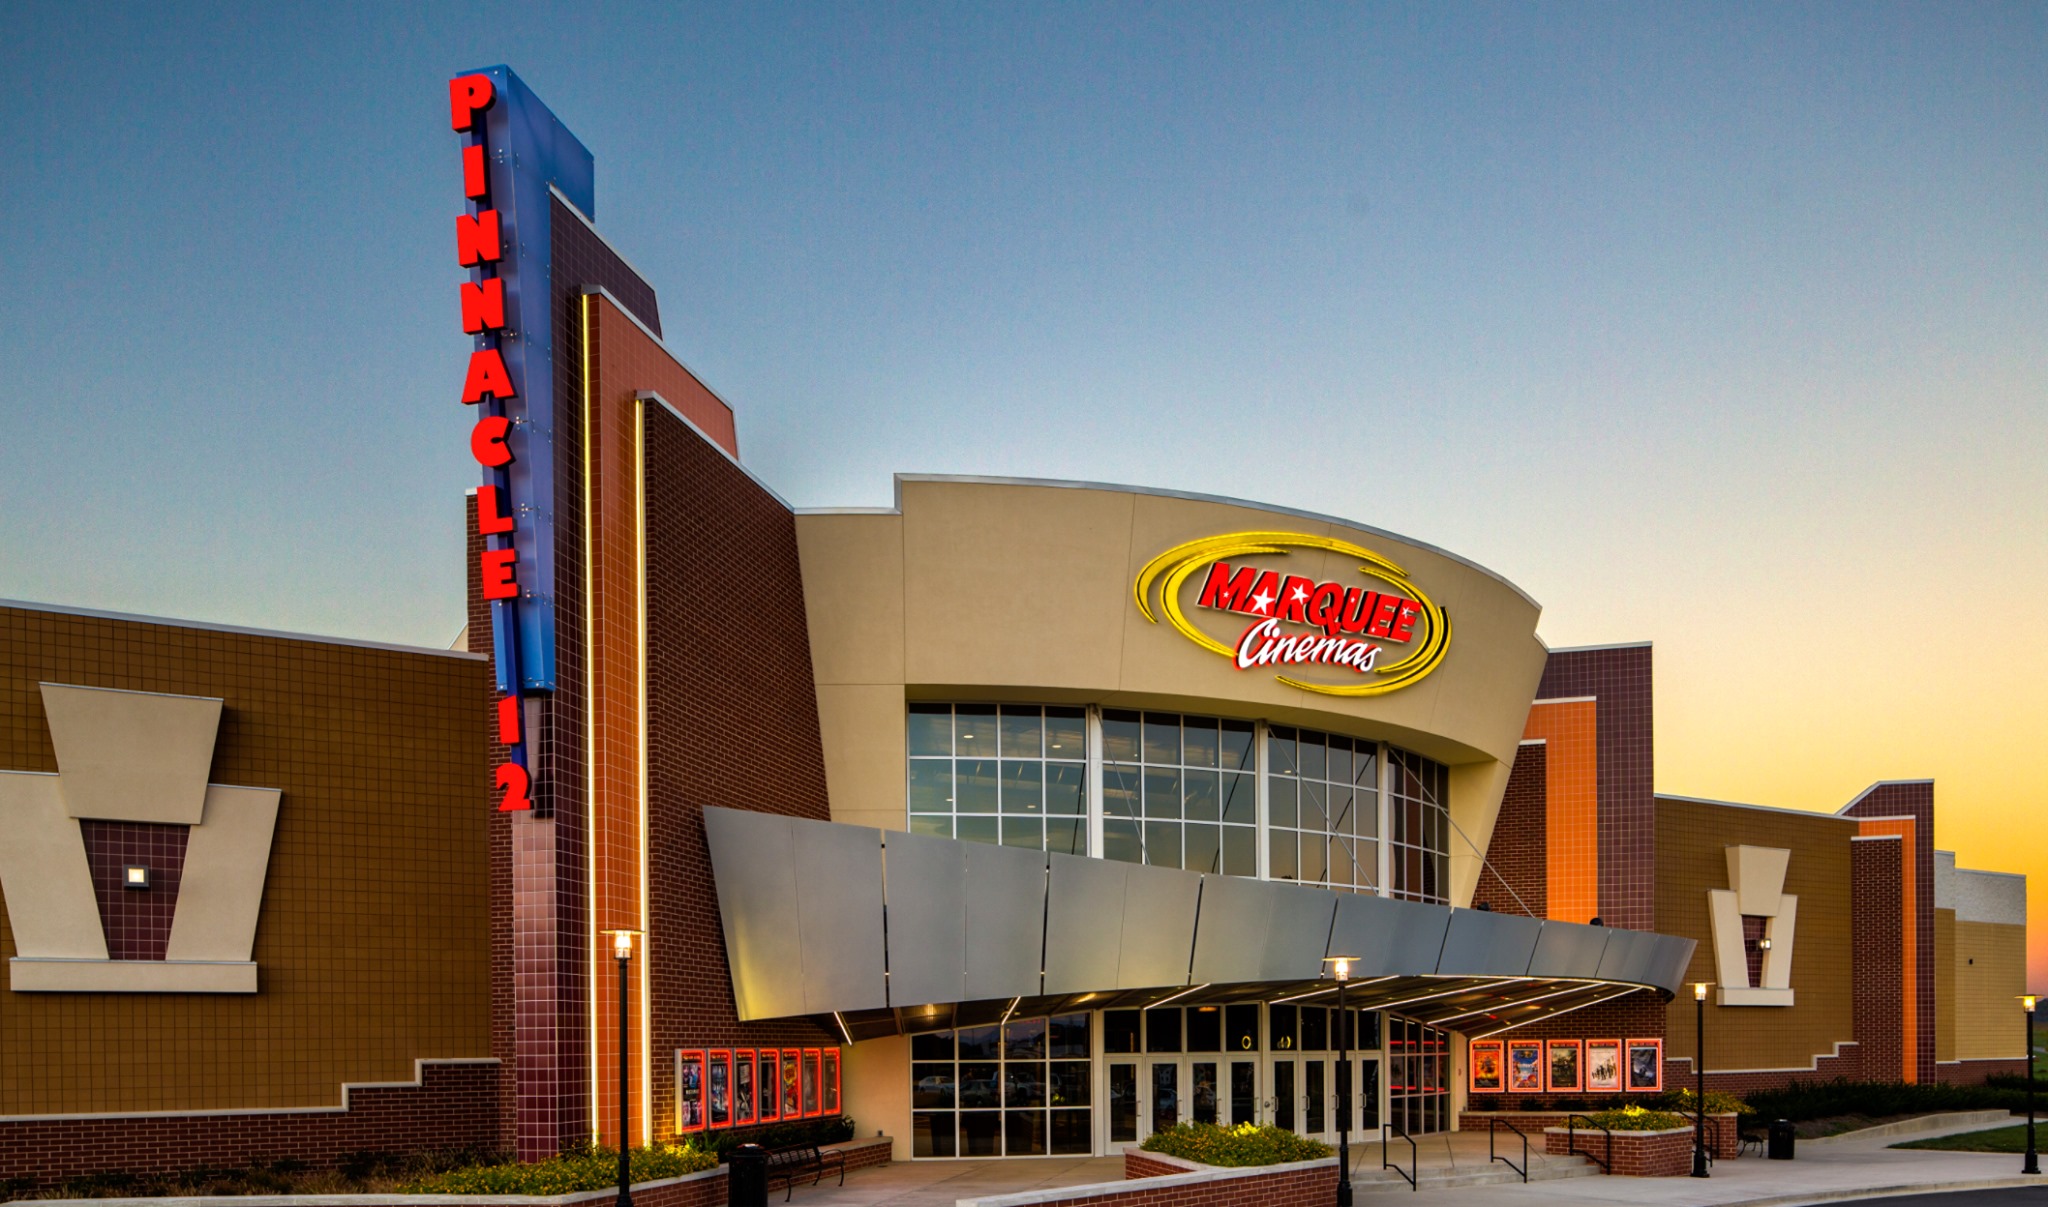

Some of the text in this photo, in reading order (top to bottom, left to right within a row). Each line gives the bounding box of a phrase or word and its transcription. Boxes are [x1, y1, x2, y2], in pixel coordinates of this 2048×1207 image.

[449, 74, 531, 812] PINNACLE 12
[1198, 562, 1422, 643] MARQUEE
[1233, 618, 1382, 672] Cinemas
